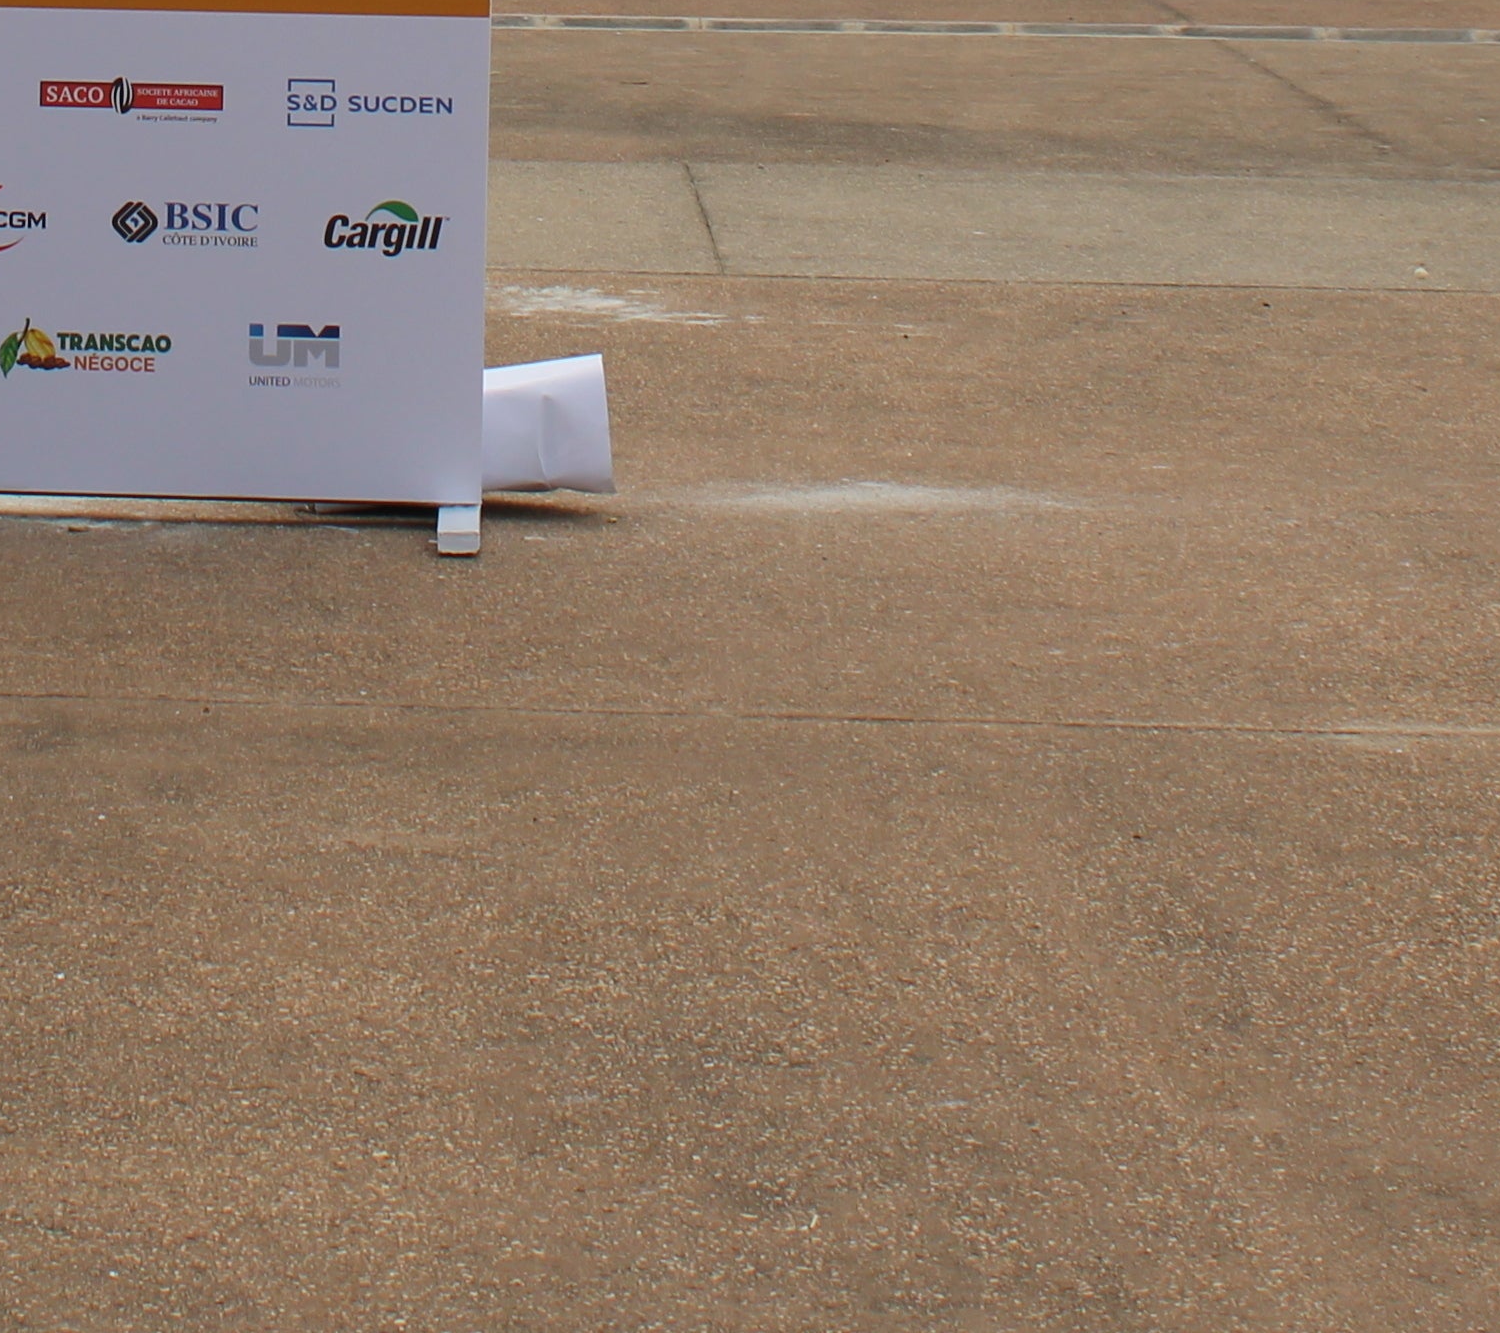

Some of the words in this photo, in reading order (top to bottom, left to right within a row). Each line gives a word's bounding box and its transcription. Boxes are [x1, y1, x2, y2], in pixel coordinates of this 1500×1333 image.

[46, 85, 104, 104] SACO
[156, 98, 168, 106] DE
[170, 99, 199, 107] CACAO
[174, 89, 218, 98] AFRICAINE
[287, 94, 338, 113] S&D
[348, 95, 453, 115] SUCDEN
[164, 202, 259, 232] BSIC
[162, 231, 196, 246] CÔTE
[199, 235, 258, 247] D'IVOIRE
[324, 214, 443, 257] Cargill
[57, 332, 171, 354] TRANSCAO
[74, 352, 155, 372] NÉGOCE
[249, 376, 291, 387] UNITED
